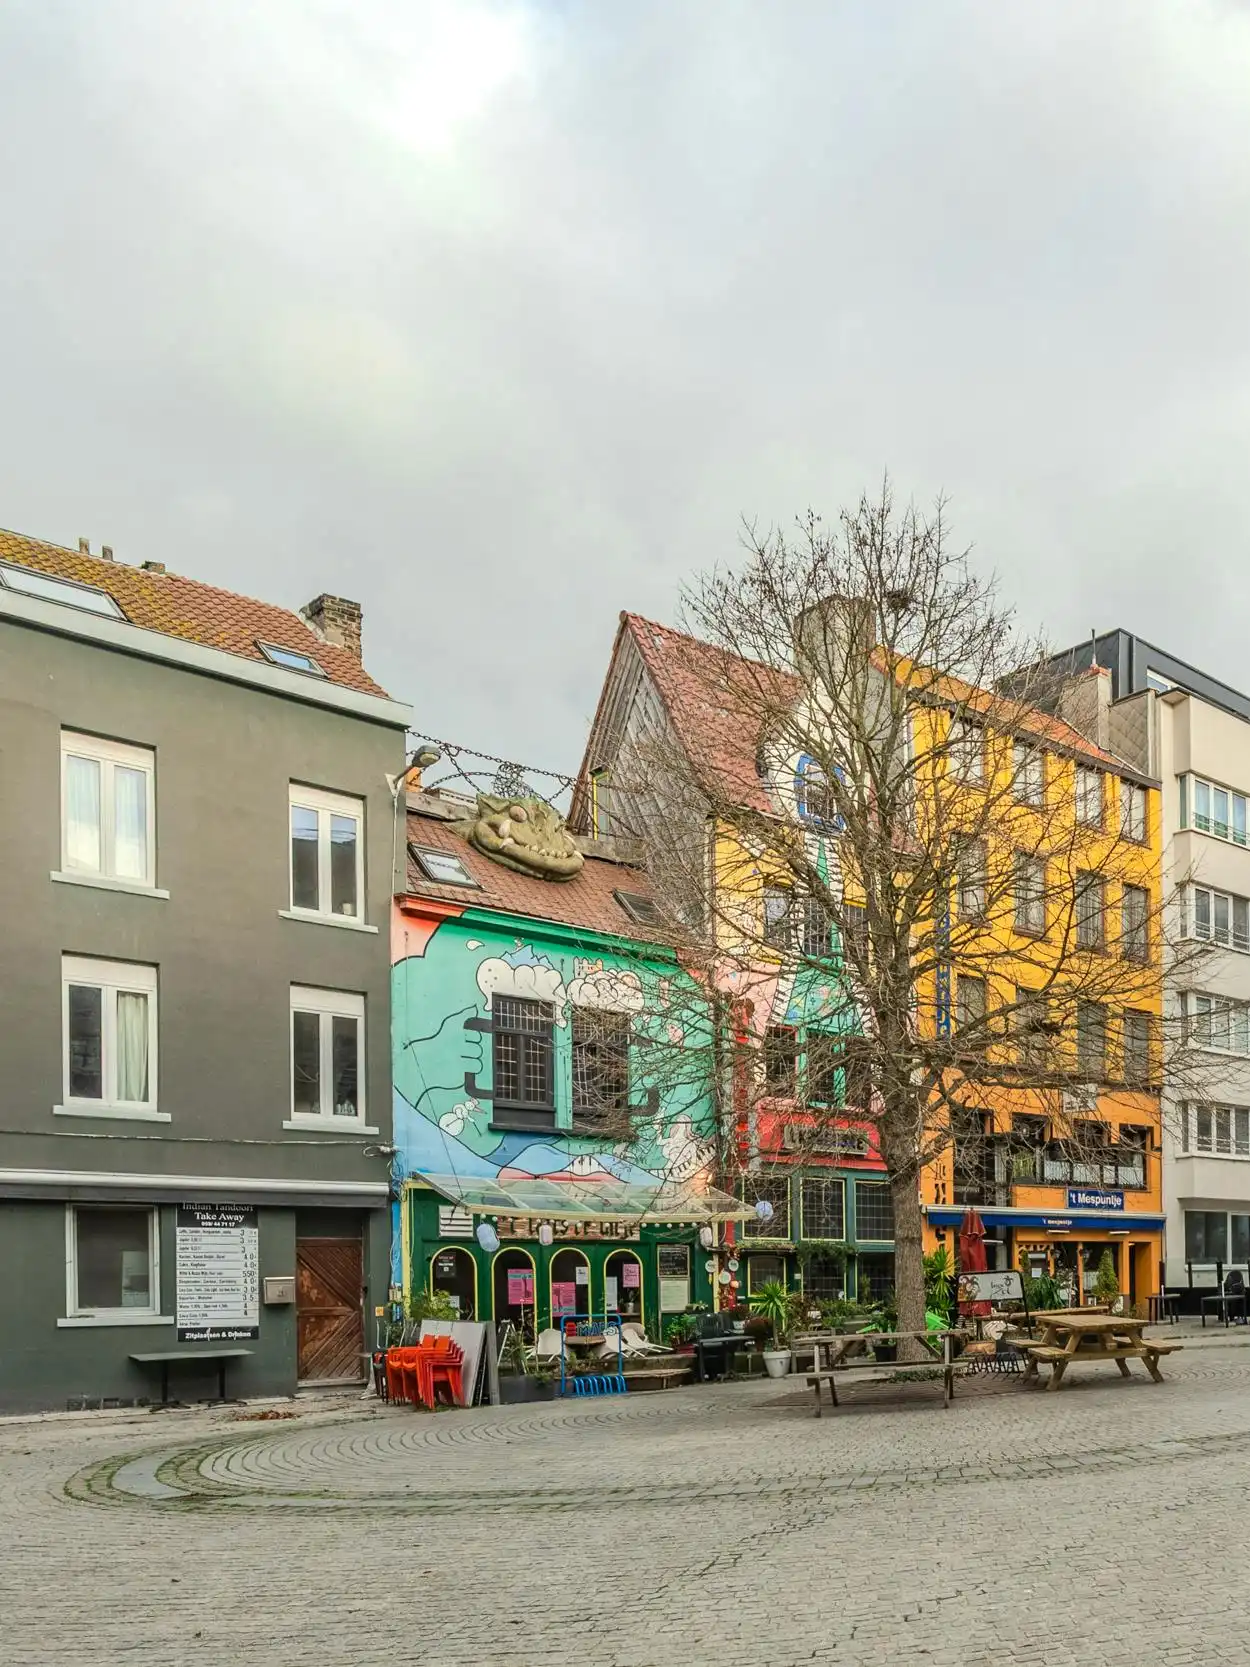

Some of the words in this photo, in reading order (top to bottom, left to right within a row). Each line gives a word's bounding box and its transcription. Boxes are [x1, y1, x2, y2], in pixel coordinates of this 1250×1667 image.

[1070, 1193, 1076, 1203] 't
[1078, 1193, 1122, 1207] Mespuntje
[194, 1212, 217, 1220] Take
[219, 1213, 244, 1222] Away
